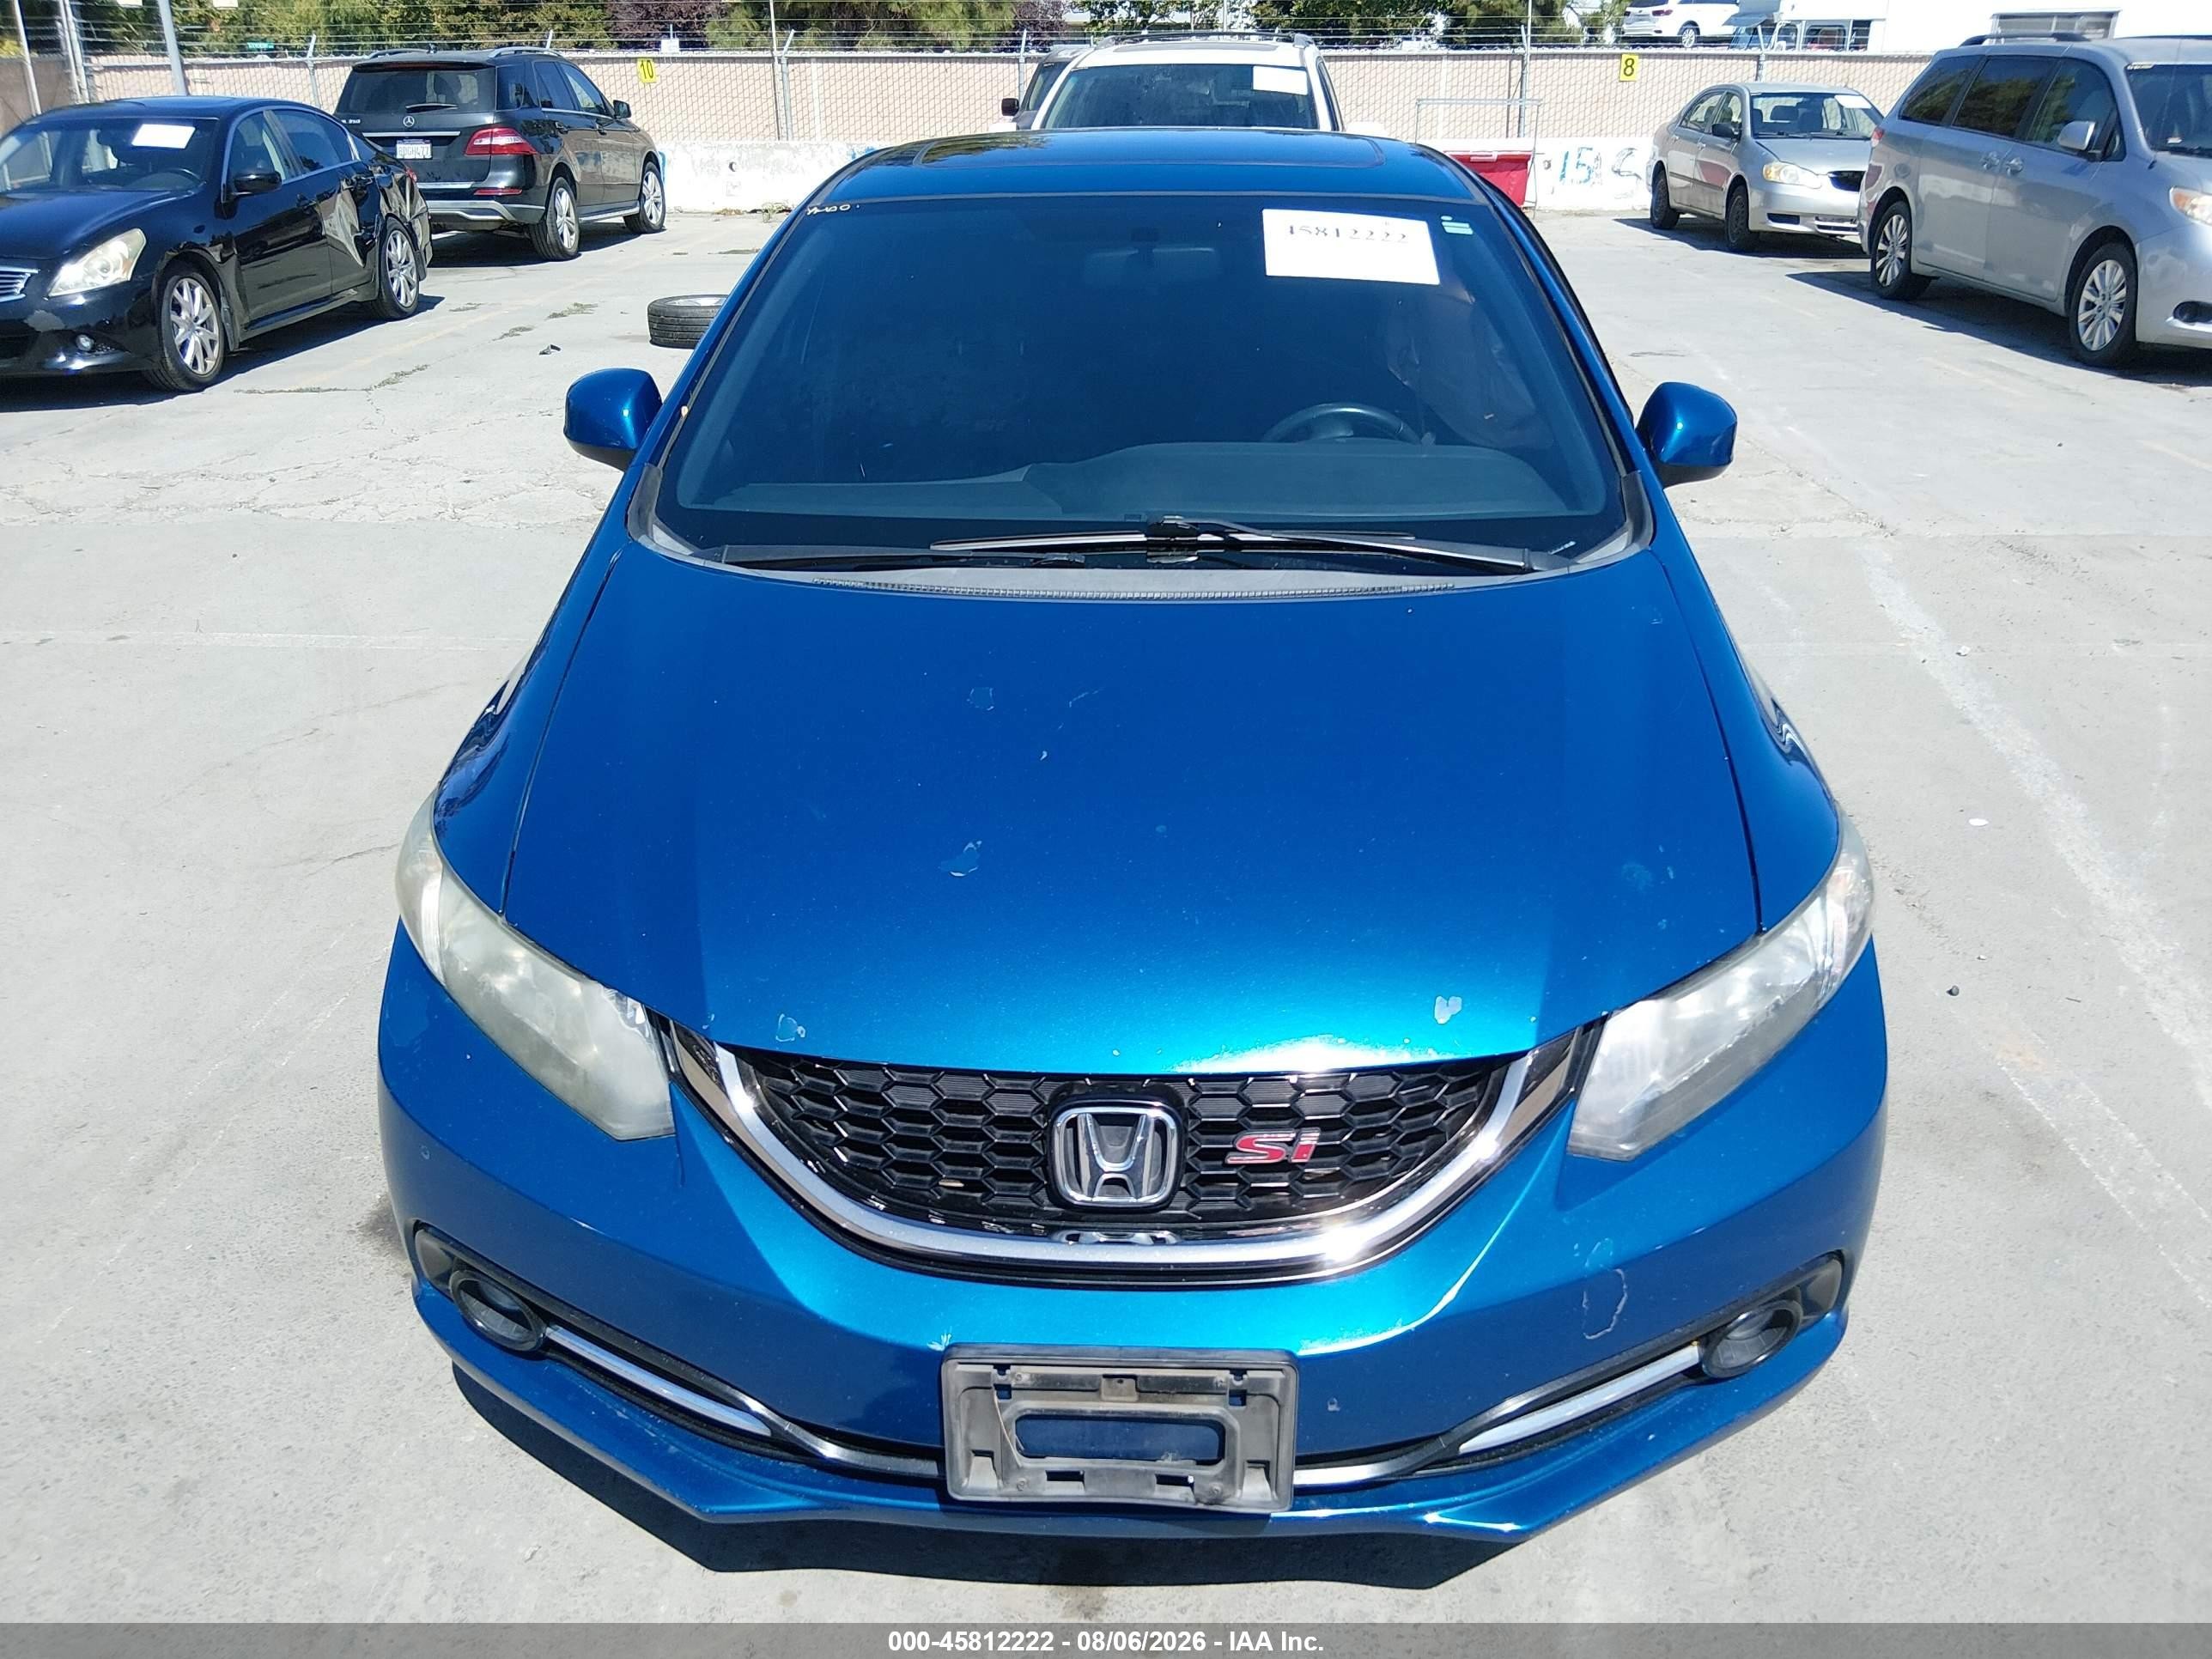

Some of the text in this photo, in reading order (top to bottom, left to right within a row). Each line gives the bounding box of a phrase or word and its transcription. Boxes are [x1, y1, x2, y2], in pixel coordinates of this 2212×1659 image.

[640, 60, 654, 79] 10
[1624, 58, 1635, 76] 8
[1225, 1128, 1321, 1164] Si
